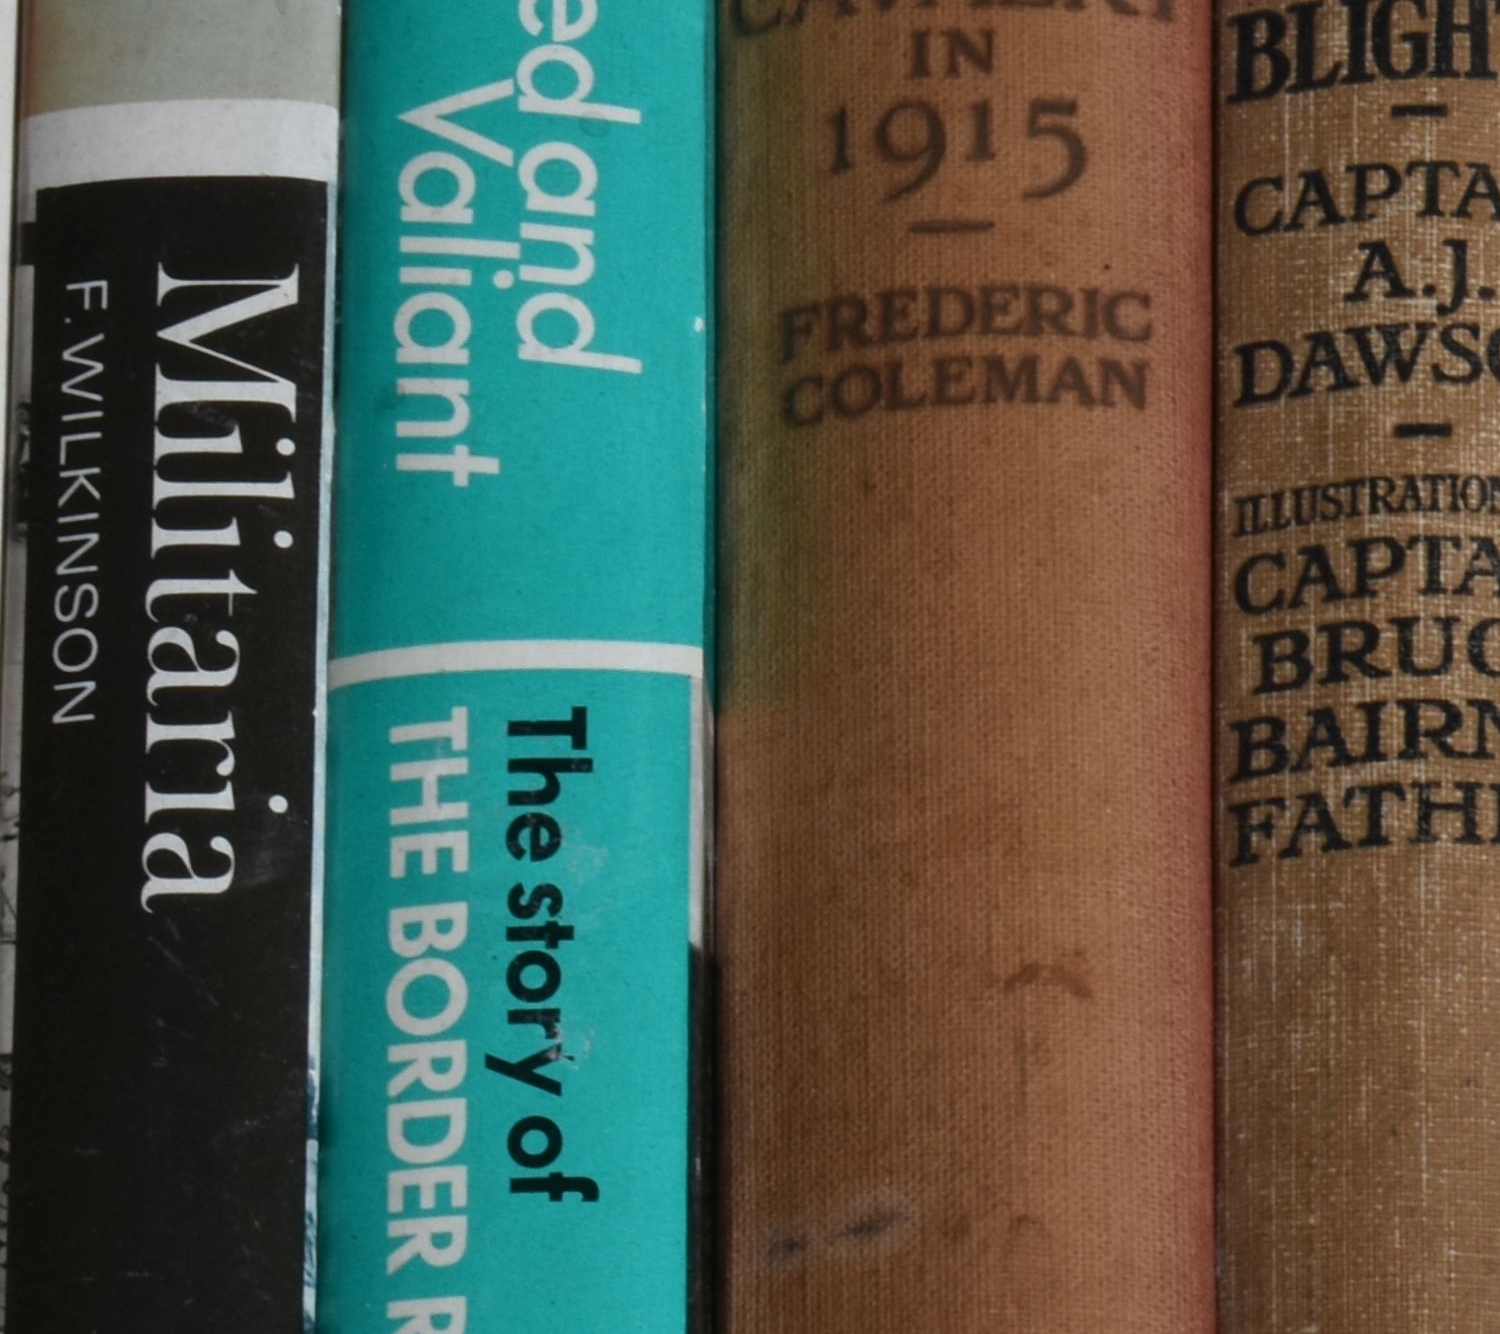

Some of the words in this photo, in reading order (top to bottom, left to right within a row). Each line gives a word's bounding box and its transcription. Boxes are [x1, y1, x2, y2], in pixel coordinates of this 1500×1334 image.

[903, 27, 995, 80] IN
[827, 97, 1090, 202] 1915
[392, 78, 521, 488] Valiant
[516, 141, 642, 375] and
[780, 282, 1153, 364] FREDERIC
[782, 353, 1150, 429] COLEMAN
[140, 261, 301, 915] Militaria
[387, 706, 469, 880] THE
[505, 706, 594, 863] The
[483, 883, 576, 1097] story
[384, 901, 469, 1276] BORDER
[505, 1115, 601, 1204] of
